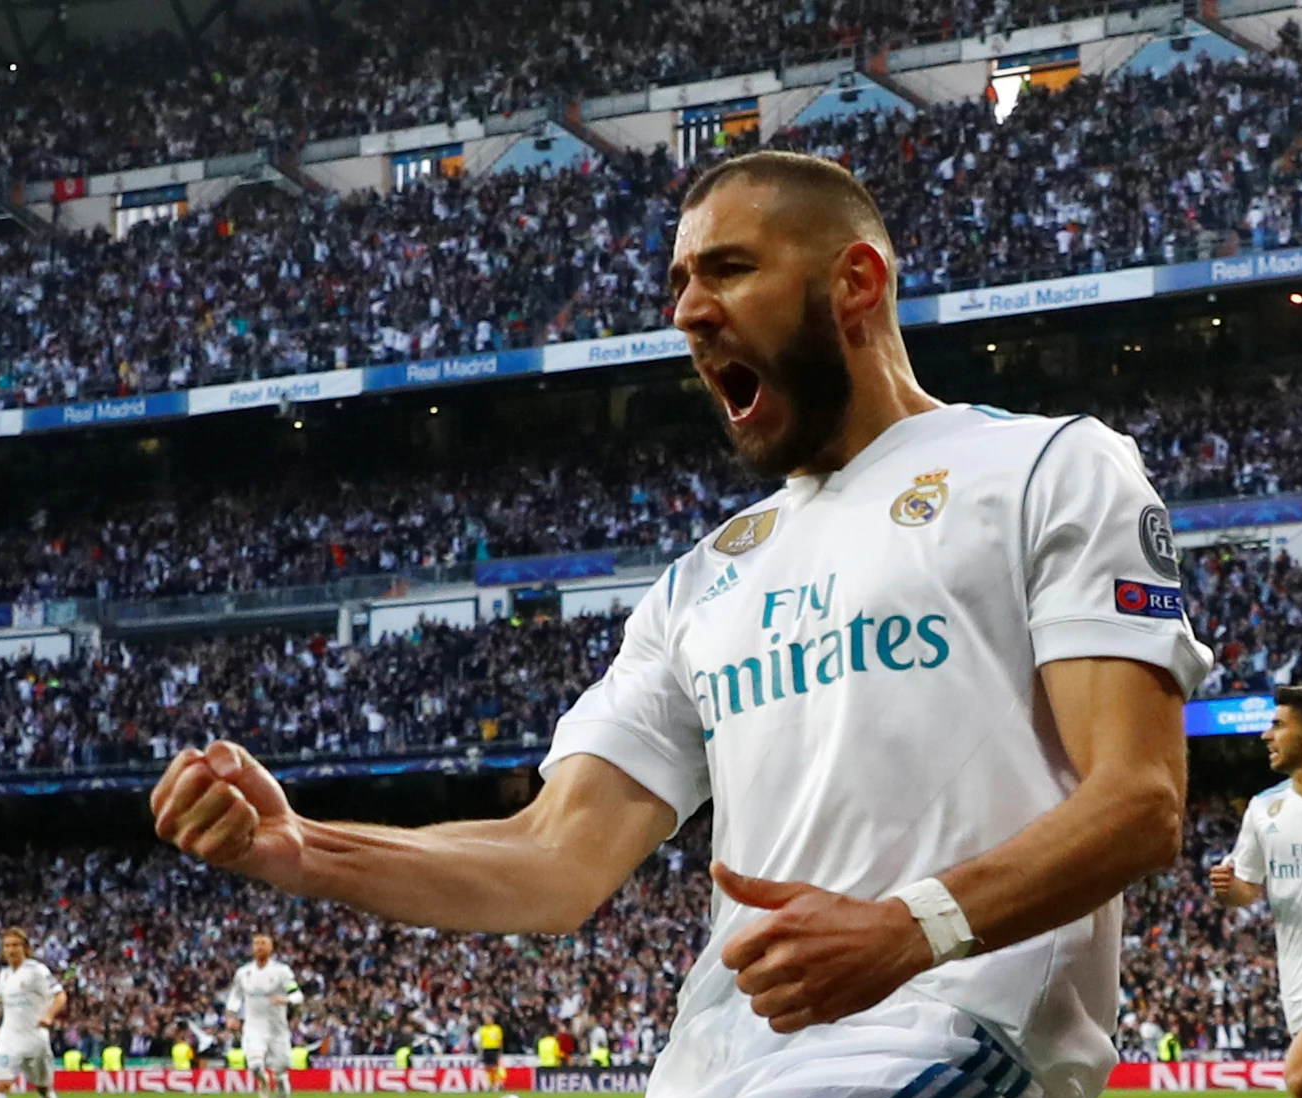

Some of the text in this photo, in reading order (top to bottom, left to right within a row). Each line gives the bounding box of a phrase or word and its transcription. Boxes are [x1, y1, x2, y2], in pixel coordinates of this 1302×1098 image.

[1211, 259, 1252, 280] Real
[988, 282, 1099, 312] Real Madrid
[589, 343, 624, 361] Real
[406, 357, 497, 380] Real Madrid
[229, 381, 320, 404] Real Madrid
[63, 398, 146, 423] Real Madrid
[762, 573, 836, 629] Fly
[95, 1069, 255, 1093] NISSAN
[539, 1073, 593, 1092] UEFA
